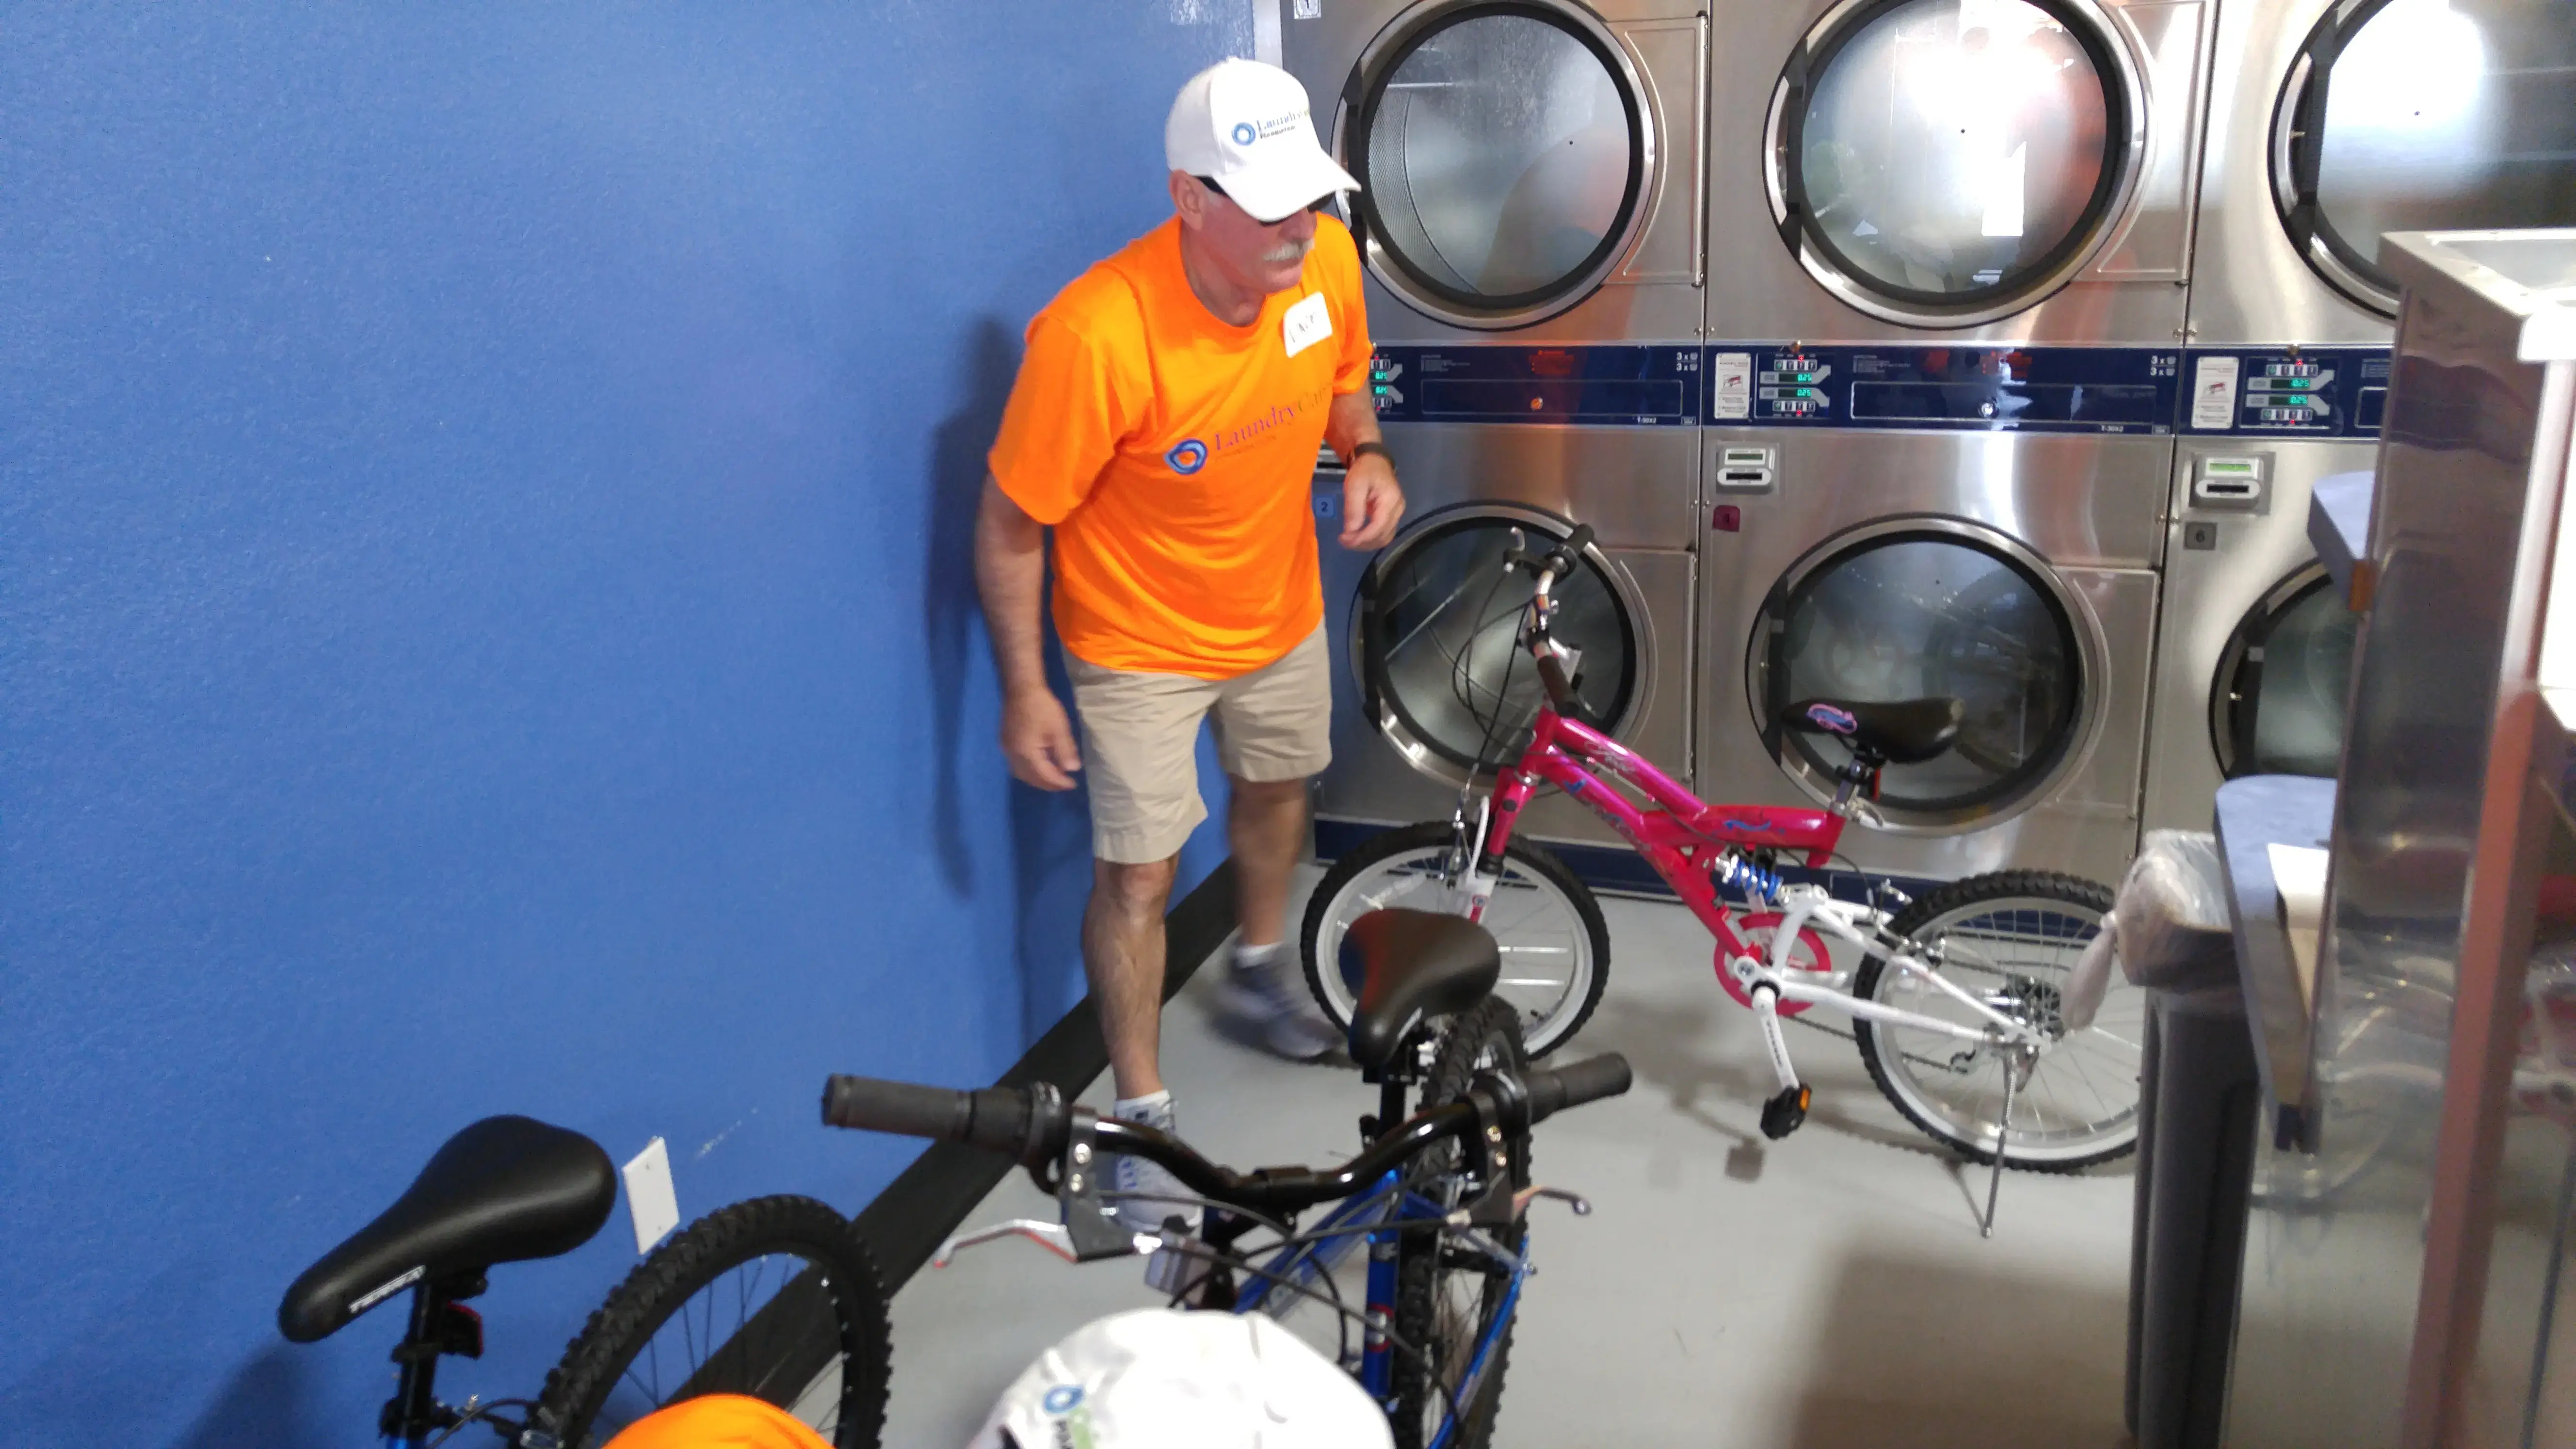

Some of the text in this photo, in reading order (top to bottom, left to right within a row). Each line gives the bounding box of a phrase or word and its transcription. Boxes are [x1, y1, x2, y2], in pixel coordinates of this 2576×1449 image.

[1676, 352, 1682, 361] 3
[2151, 355, 2157, 364] 3
[1676, 362, 1682, 372] 3
[2150, 367, 2157, 376] 3
[1321, 501, 1328, 512] 2
